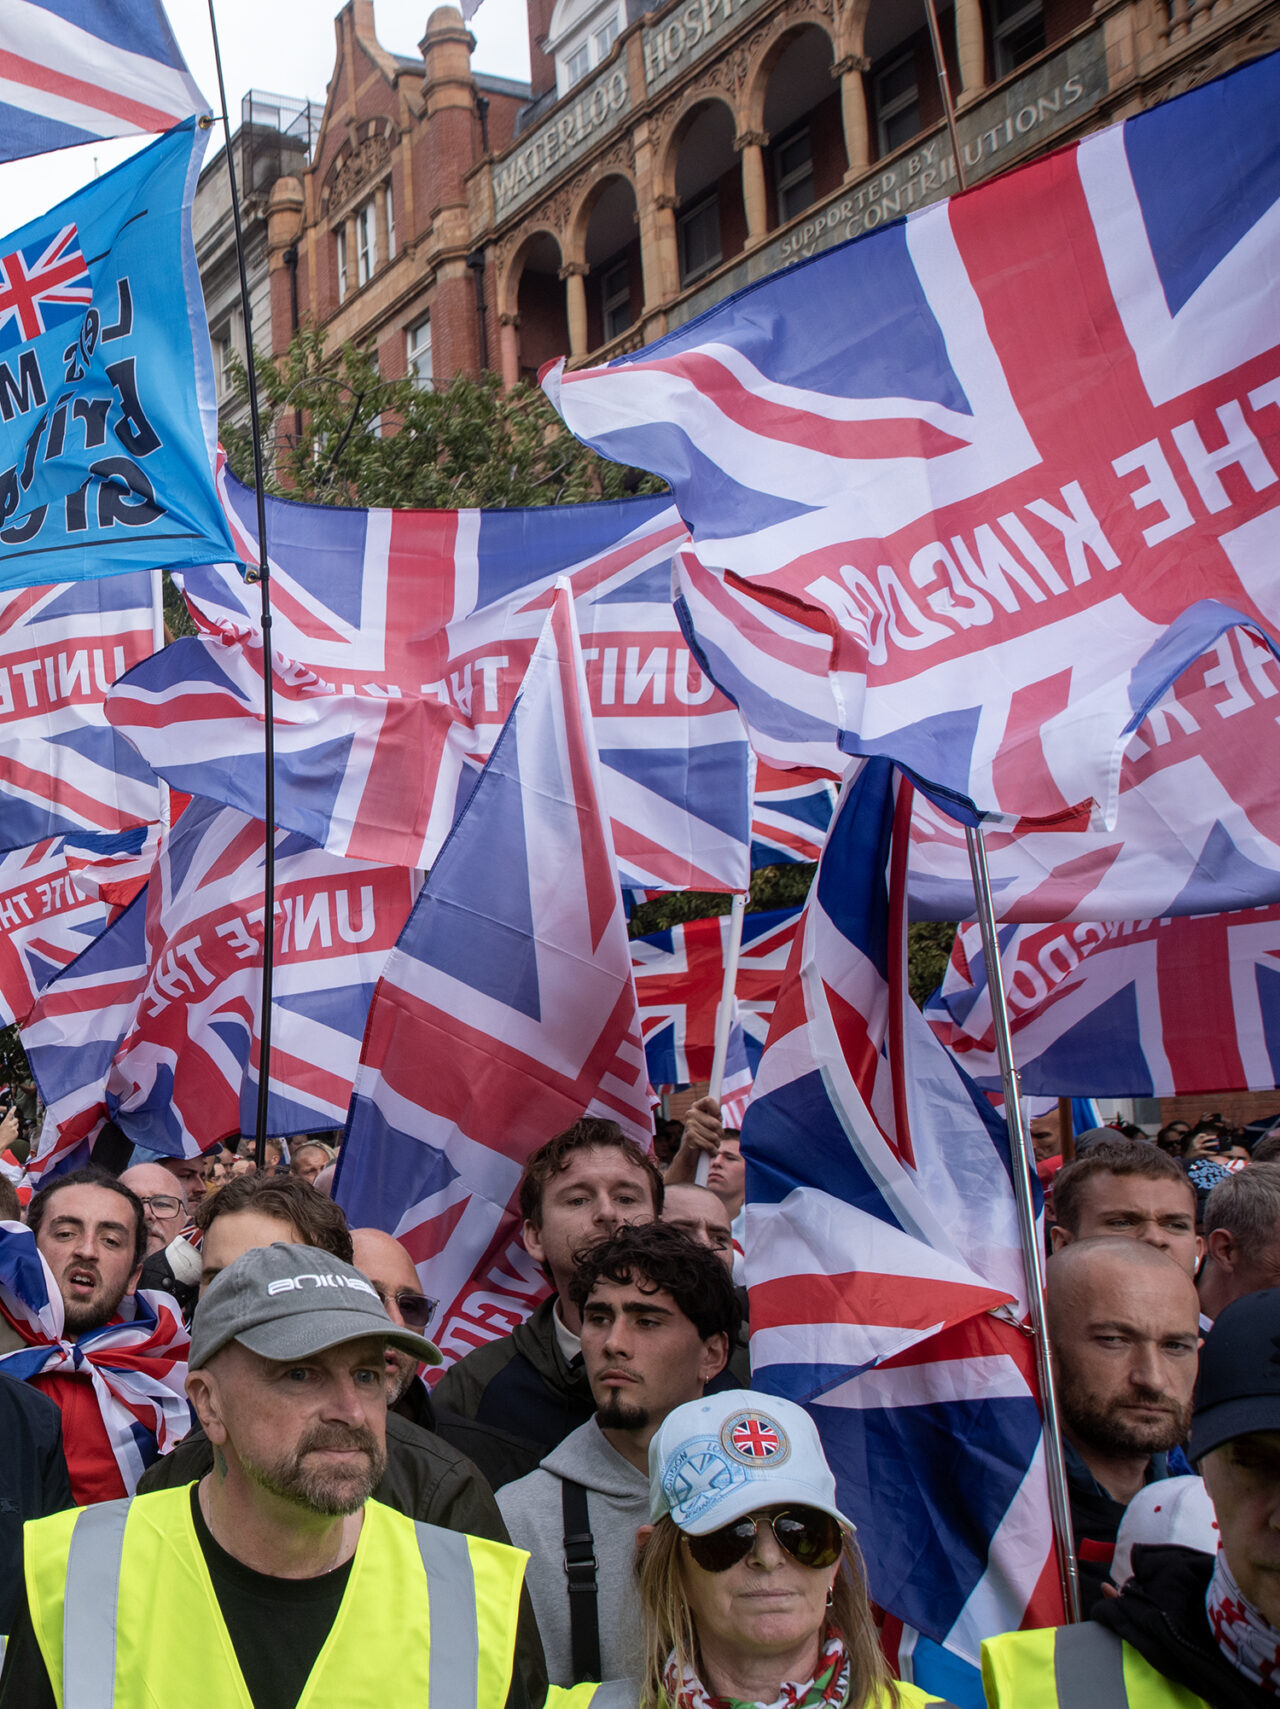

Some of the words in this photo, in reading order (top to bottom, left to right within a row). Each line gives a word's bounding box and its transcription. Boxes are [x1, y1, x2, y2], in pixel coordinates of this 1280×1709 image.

[493, 70, 629, 207] WATERLOO
[780, 170, 896, 258] SUPPORTED
[907, 142, 937, 178] BY
[845, 74, 1084, 240] CONTRIUTIONS
